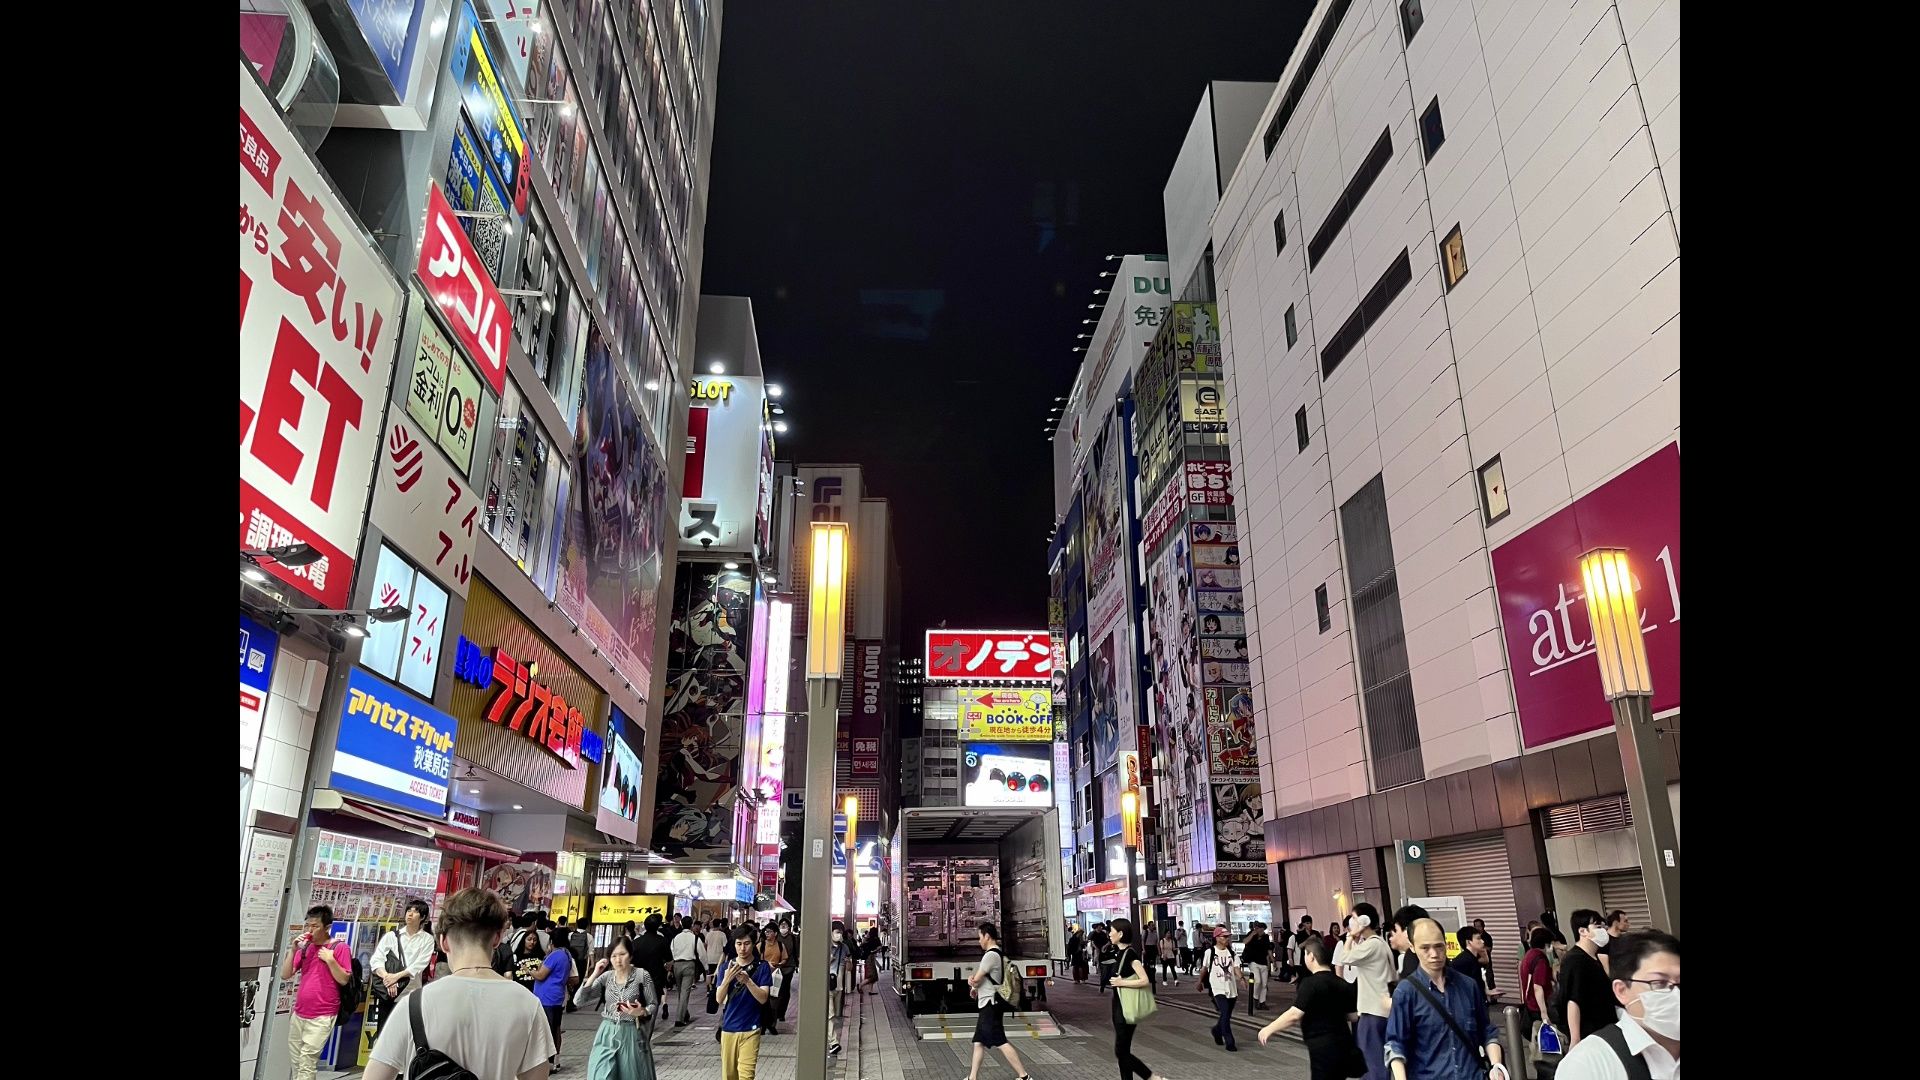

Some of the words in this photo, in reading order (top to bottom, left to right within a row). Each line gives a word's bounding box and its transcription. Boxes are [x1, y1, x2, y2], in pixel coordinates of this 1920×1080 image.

[428, 212, 502, 370] アコム
[414, 370, 443, 420] 金利
[445, 386, 468, 450] 0円
[1191, 492, 1204, 502] 6F
[863, 645, 881, 679] Duty
[933, 634, 1050, 673] オノデン
[487, 648, 585, 770] ラジオ会館
[863, 681, 880, 714] Free
[347, 687, 454, 754] アクセスチケット
[989, 726, 1051, 734] 現在地から徒歩4分
[413, 745, 450, 779] 秋葉原店
[409, 780, 429, 796] ACCESS
[429, 785, 444, 799] TICKET
[628, 906, 662, 914] ライオン
